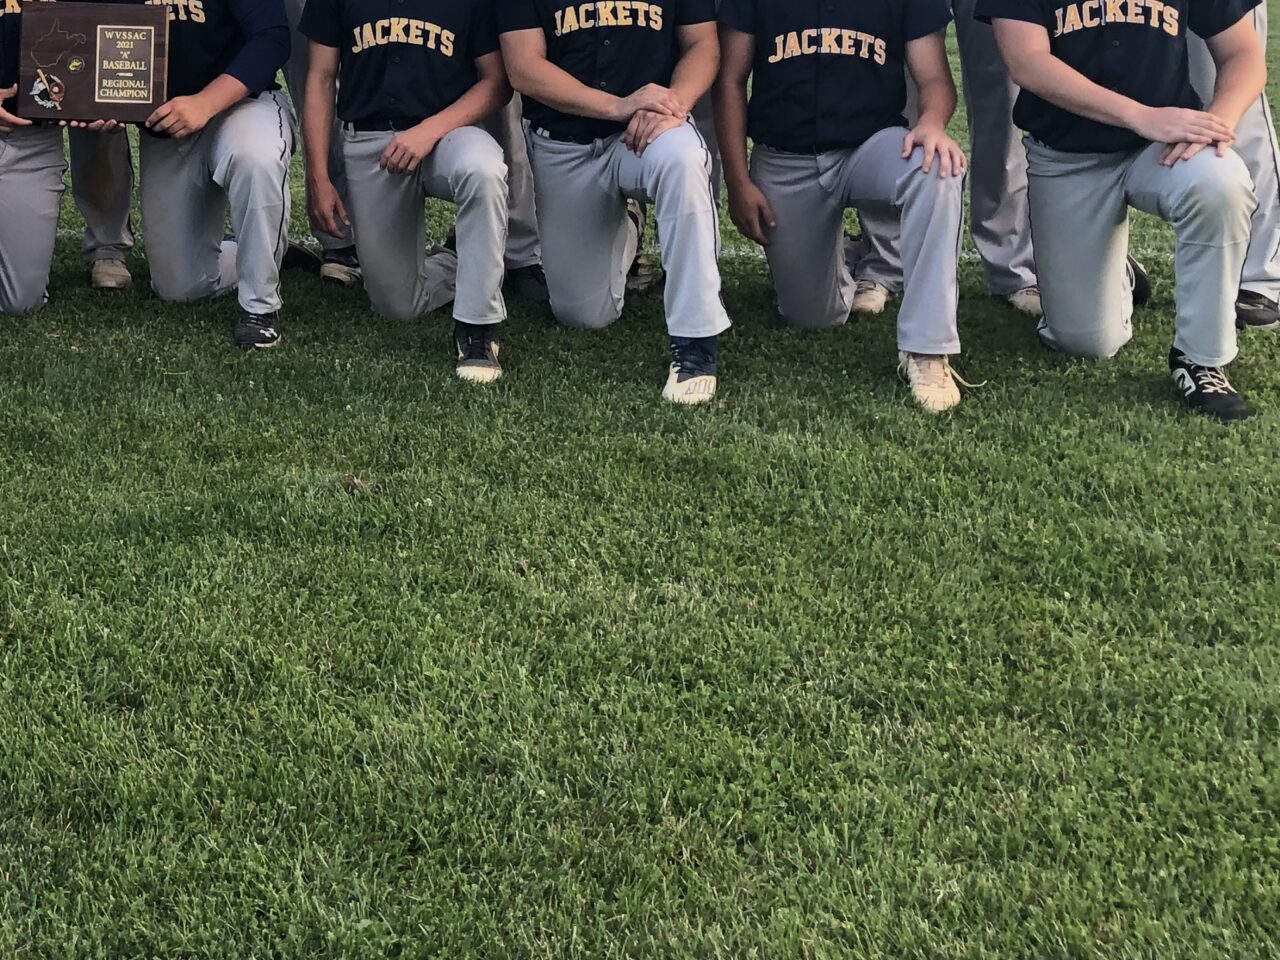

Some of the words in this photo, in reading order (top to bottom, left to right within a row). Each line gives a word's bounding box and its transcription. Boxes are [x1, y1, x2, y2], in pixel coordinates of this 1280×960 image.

[554, 0, 663, 37] JACKETS
[104, 31, 147, 41] WVSSAC
[351, 17, 455, 57] JACKETS
[116, 41, 134, 49] 2021
[768, 27, 886, 66] JACKETS
[102, 60, 147, 71] BASEBALL
[102, 78, 146, 89] REGIONAL
[99, 88, 148, 98] CHAMPION
